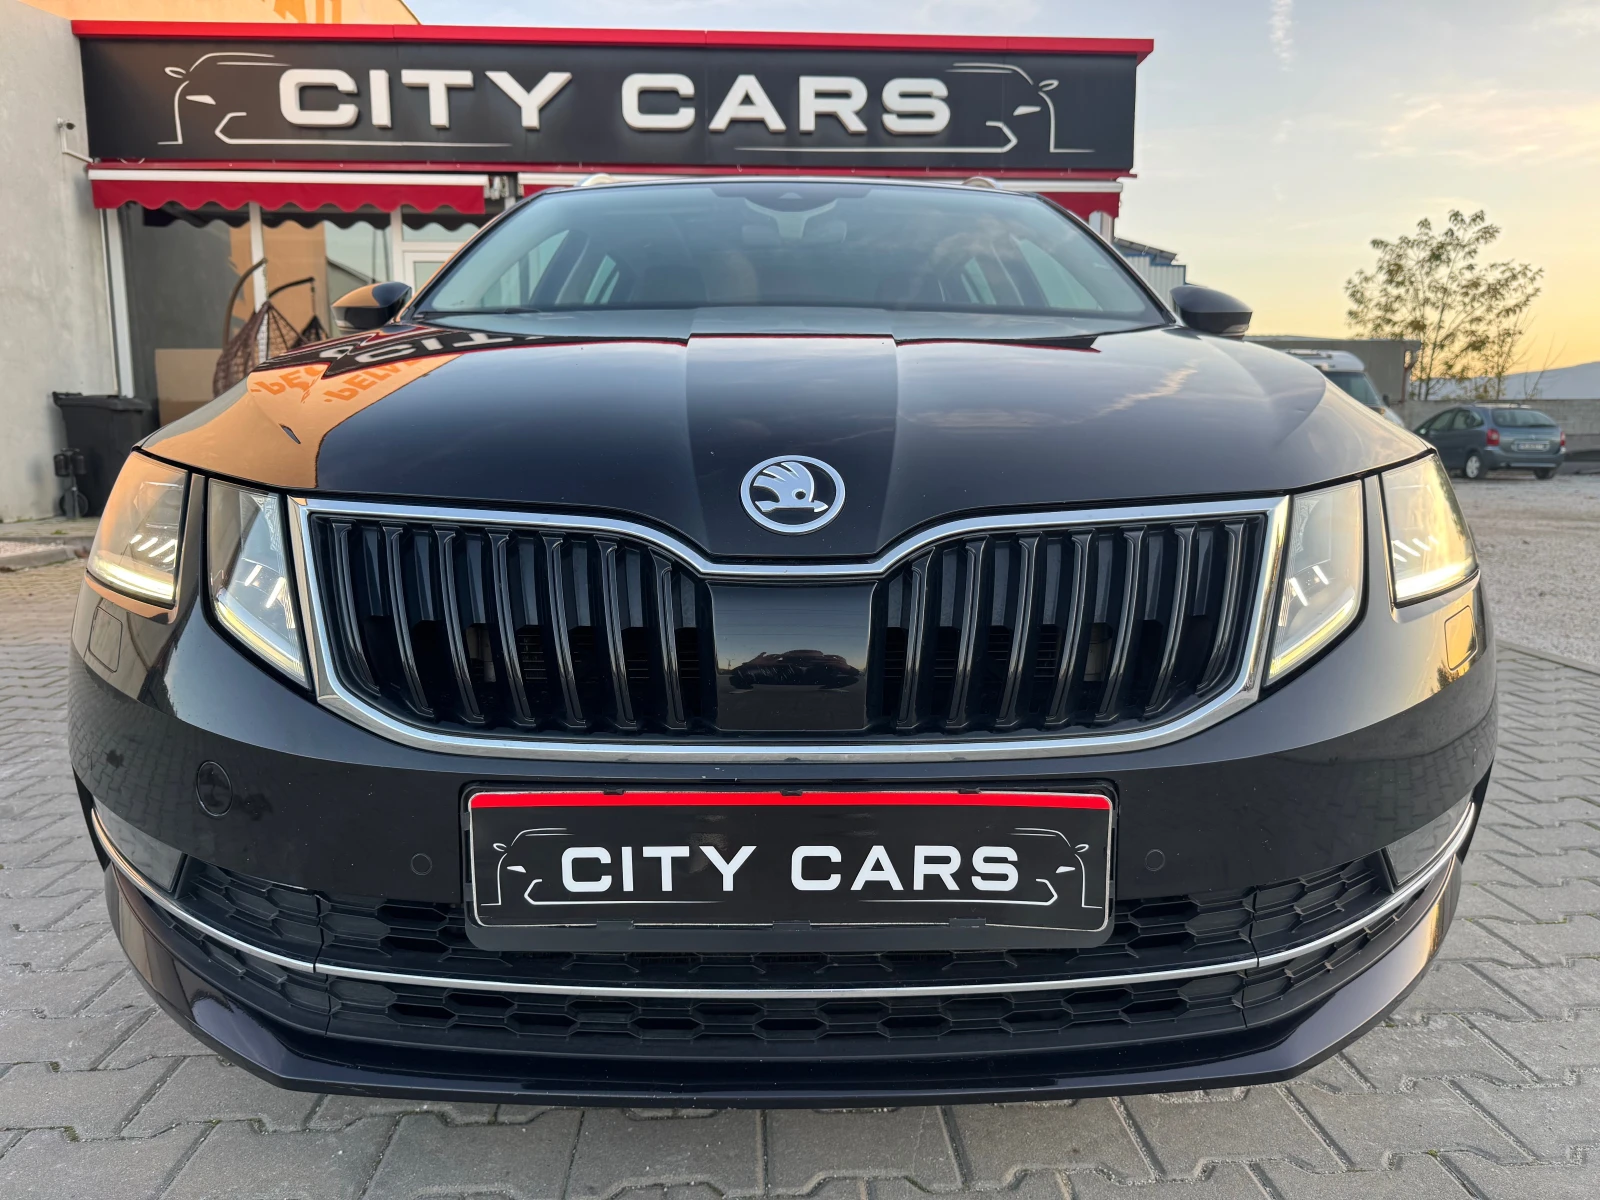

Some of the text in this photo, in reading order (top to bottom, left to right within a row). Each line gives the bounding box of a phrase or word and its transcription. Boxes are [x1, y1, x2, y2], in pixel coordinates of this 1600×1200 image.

[279, 68, 951, 134] CITY CARS
[561, 845, 1019, 893] CITY CARS
